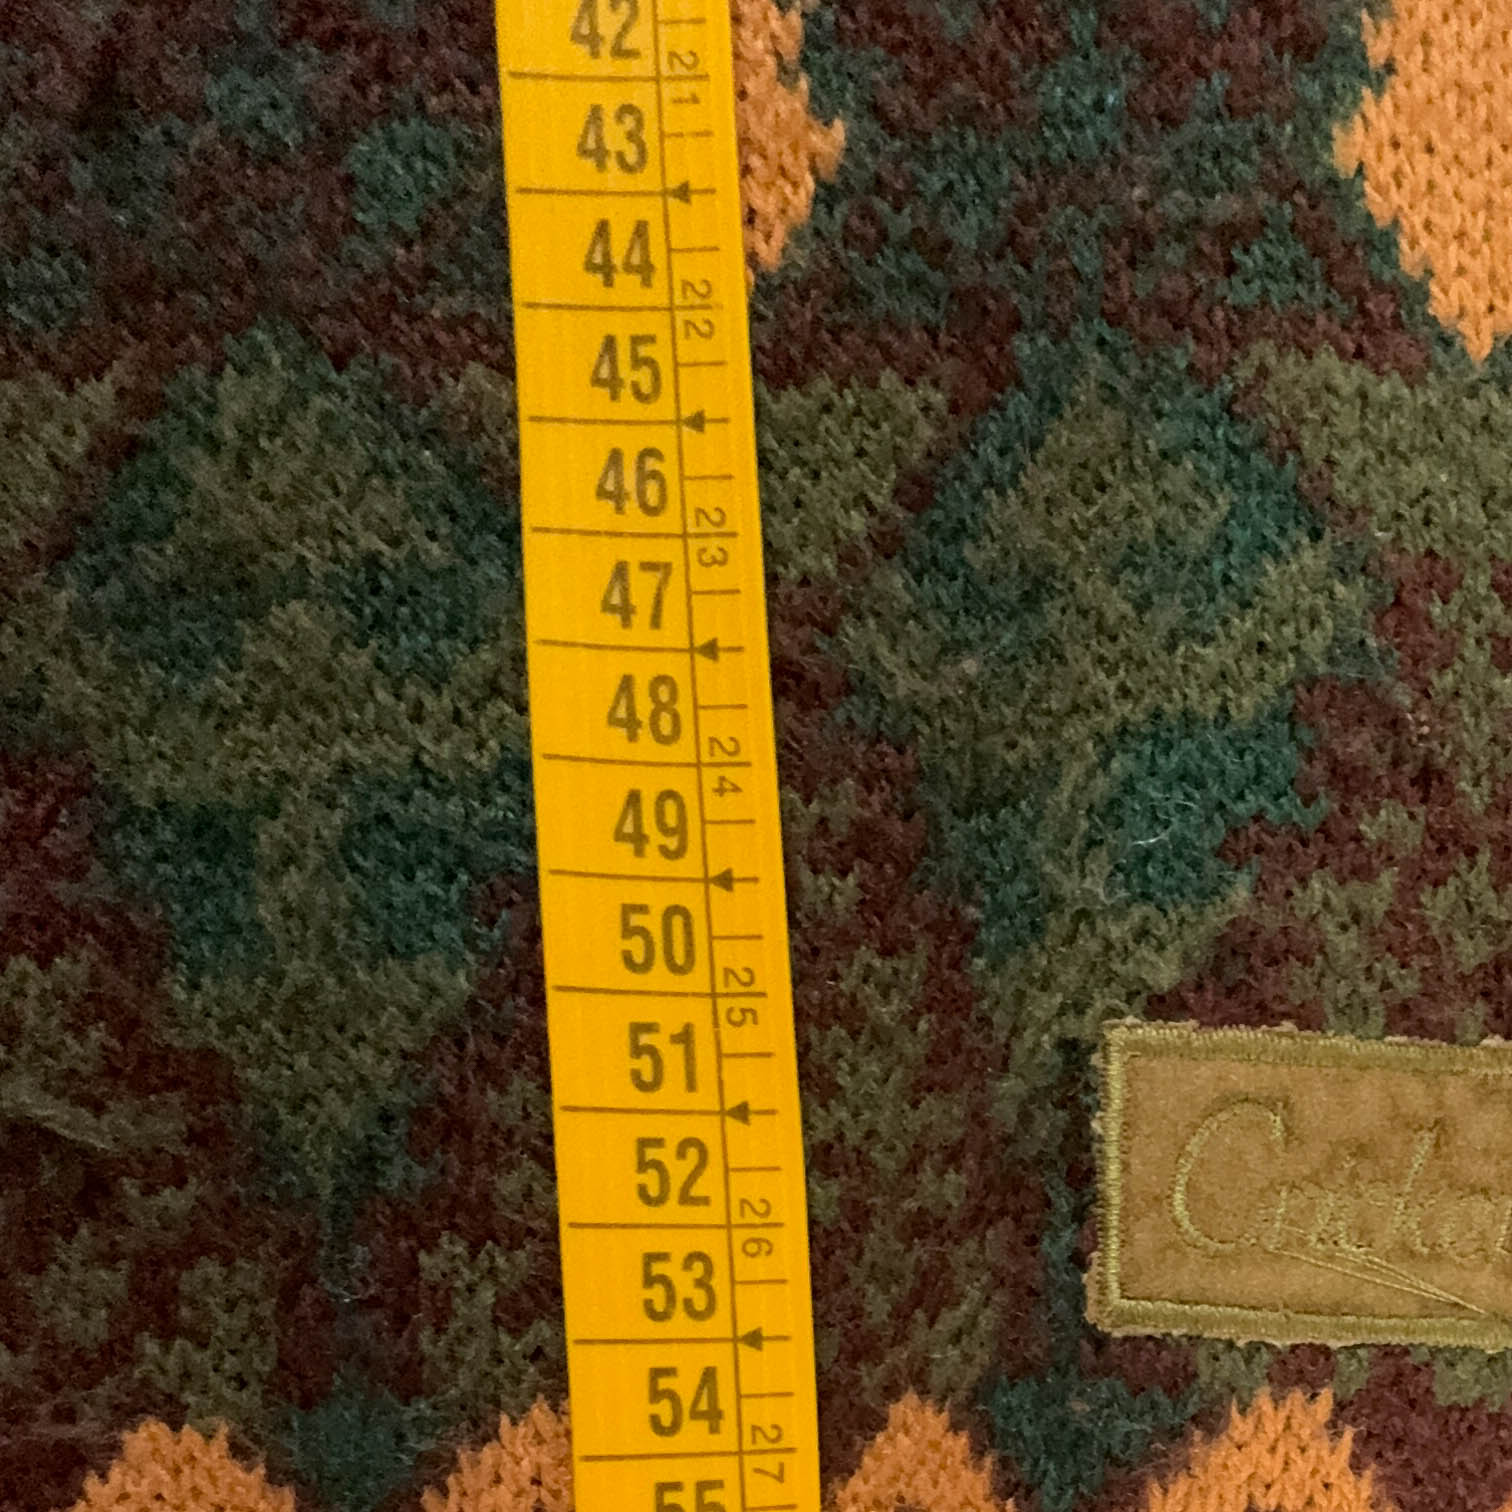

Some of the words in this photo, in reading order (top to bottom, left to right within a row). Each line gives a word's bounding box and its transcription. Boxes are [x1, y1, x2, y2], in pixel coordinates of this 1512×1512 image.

[570, 0, 641, 60] 42
[576, 103, 648, 174] 43
[583, 219, 655, 289] 44
[590, 334, 662, 404] 45
[596, 447, 668, 517] 46
[601, 560, 673, 630] 47
[607, 674, 682, 745] 48
[613, 788, 689, 861] 49
[620, 903, 696, 976] 50
[628, 1022, 697, 1094] 51
[635, 1136, 711, 1207] 52
[641, 1250, 717, 1323] 53
[648, 1366, 723, 1437] 54
